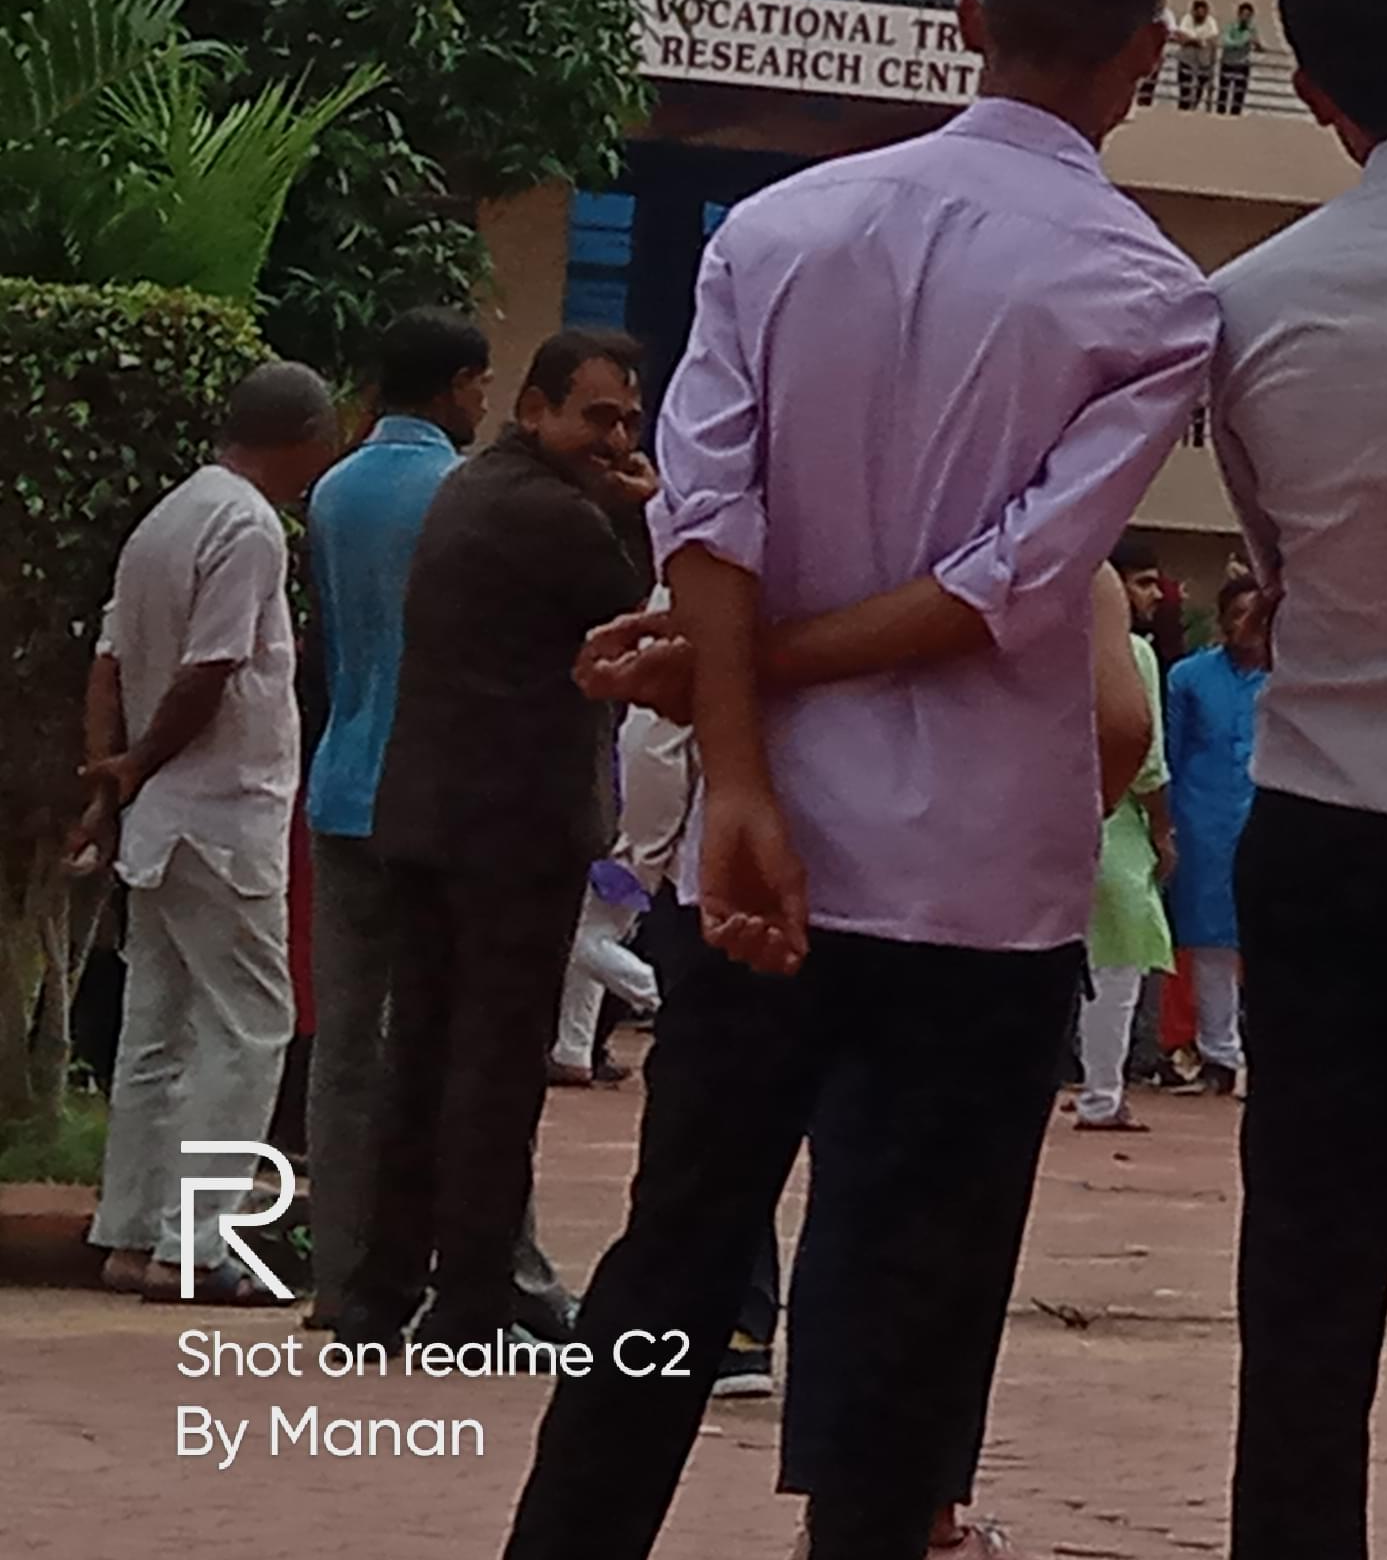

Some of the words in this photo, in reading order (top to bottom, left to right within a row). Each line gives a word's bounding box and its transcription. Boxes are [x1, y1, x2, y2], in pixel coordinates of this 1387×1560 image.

[911, 19, 958, 52] TR
[661, 36, 861, 85] RESEARCH
[877, 57, 975, 95] CENT
